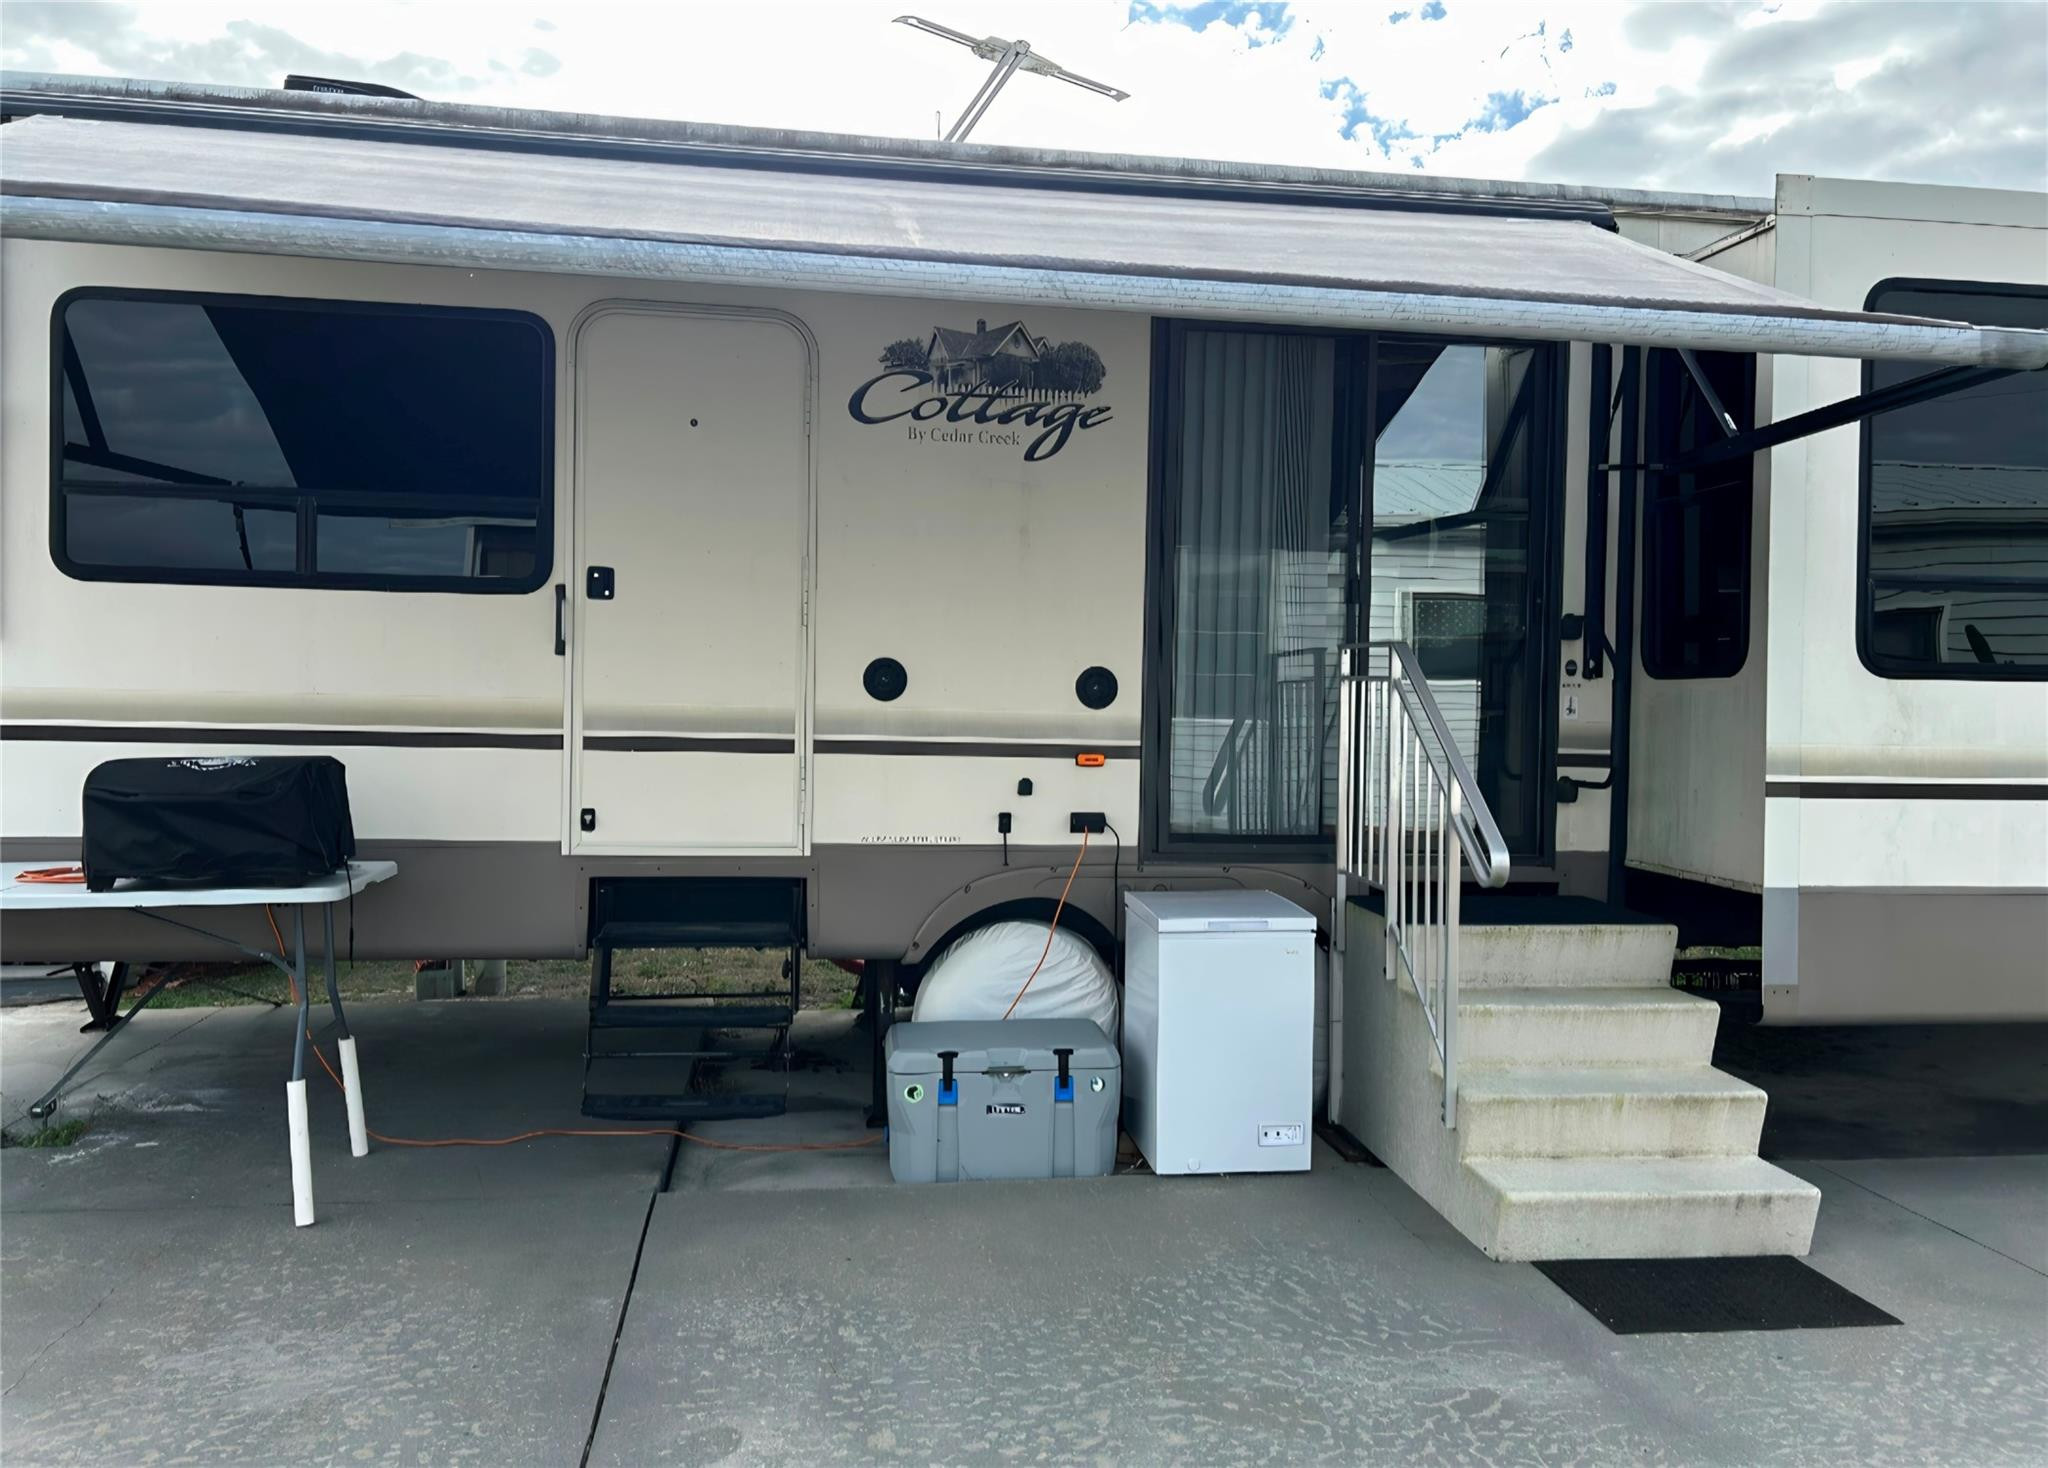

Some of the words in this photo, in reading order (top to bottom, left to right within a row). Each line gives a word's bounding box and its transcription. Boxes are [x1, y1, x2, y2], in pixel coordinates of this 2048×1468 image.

[848, 369, 1113, 462] Cottage
[908, 426, 926, 444] By
[930, 427, 973, 443] Cedar
[978, 430, 1020, 445] Creek
